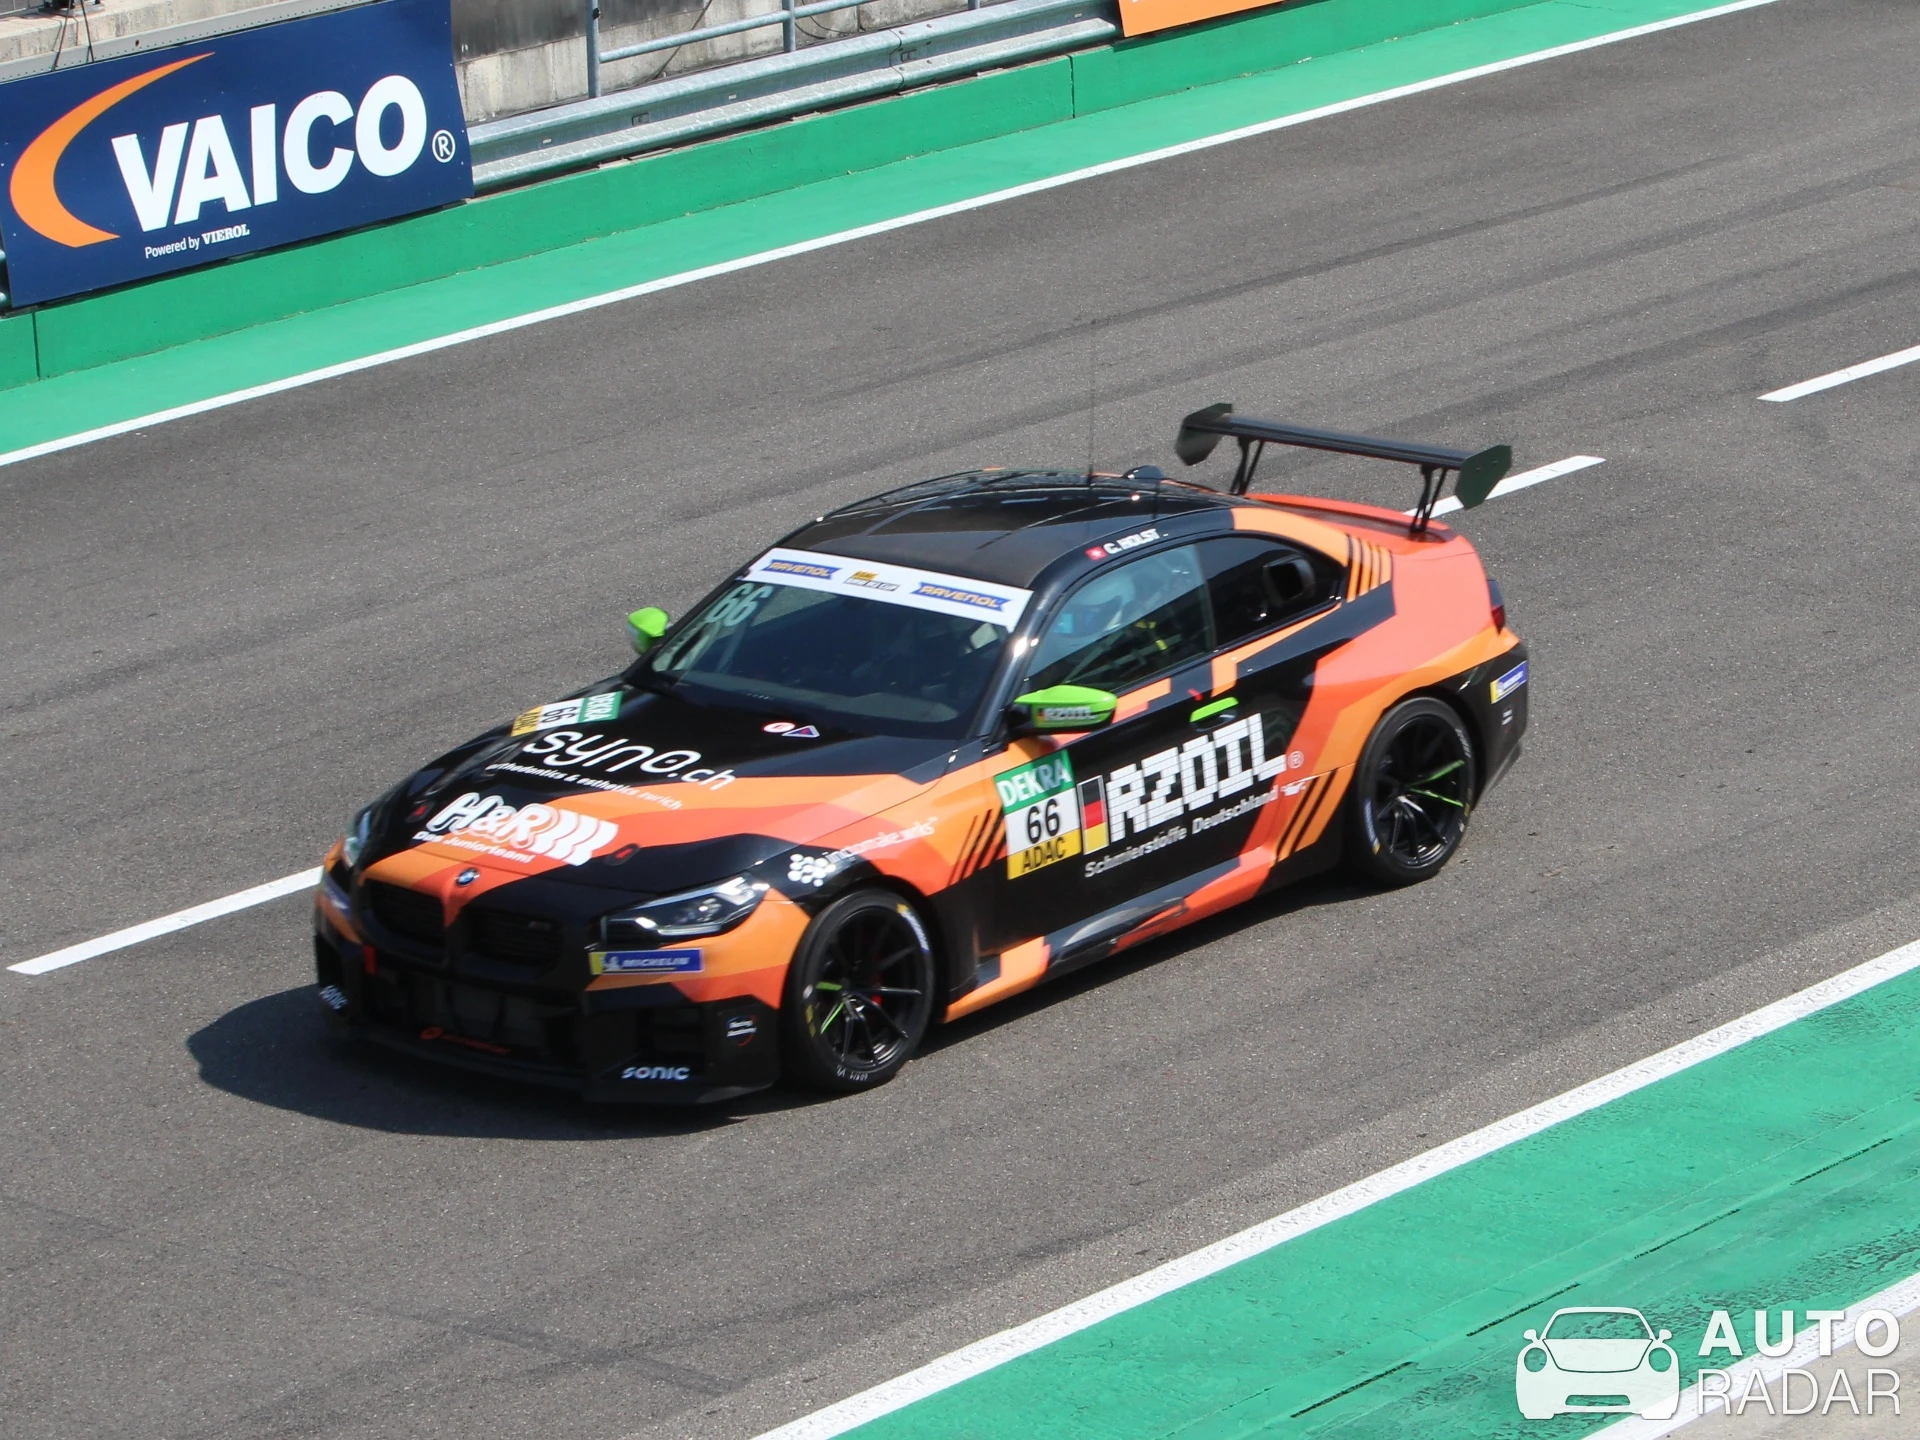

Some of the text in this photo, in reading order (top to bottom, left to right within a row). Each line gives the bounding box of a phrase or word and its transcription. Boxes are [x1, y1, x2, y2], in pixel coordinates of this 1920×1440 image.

[111, 75, 427, 232] VAICO
[145, 223, 250, 259] Powered by VIEROL
[705, 583, 774, 627] 66
[919, 585, 1002, 609] RAVENOL
[541, 706, 578, 723] 66
[522, 731, 736, 791] syno.ch
[997, 758, 1072, 808] DEKRA
[1106, 713, 1287, 843] RZOIL
[426, 792, 556, 848] H&R
[1026, 798, 1061, 844] 66
[1192, 784, 1279, 835] Deutschland
[412, 831, 445, 844] Das
[1022, 836, 1067, 874] ADAC
[621, 957, 691, 969] MICHELIN
[621, 1065, 691, 1081] sonic
